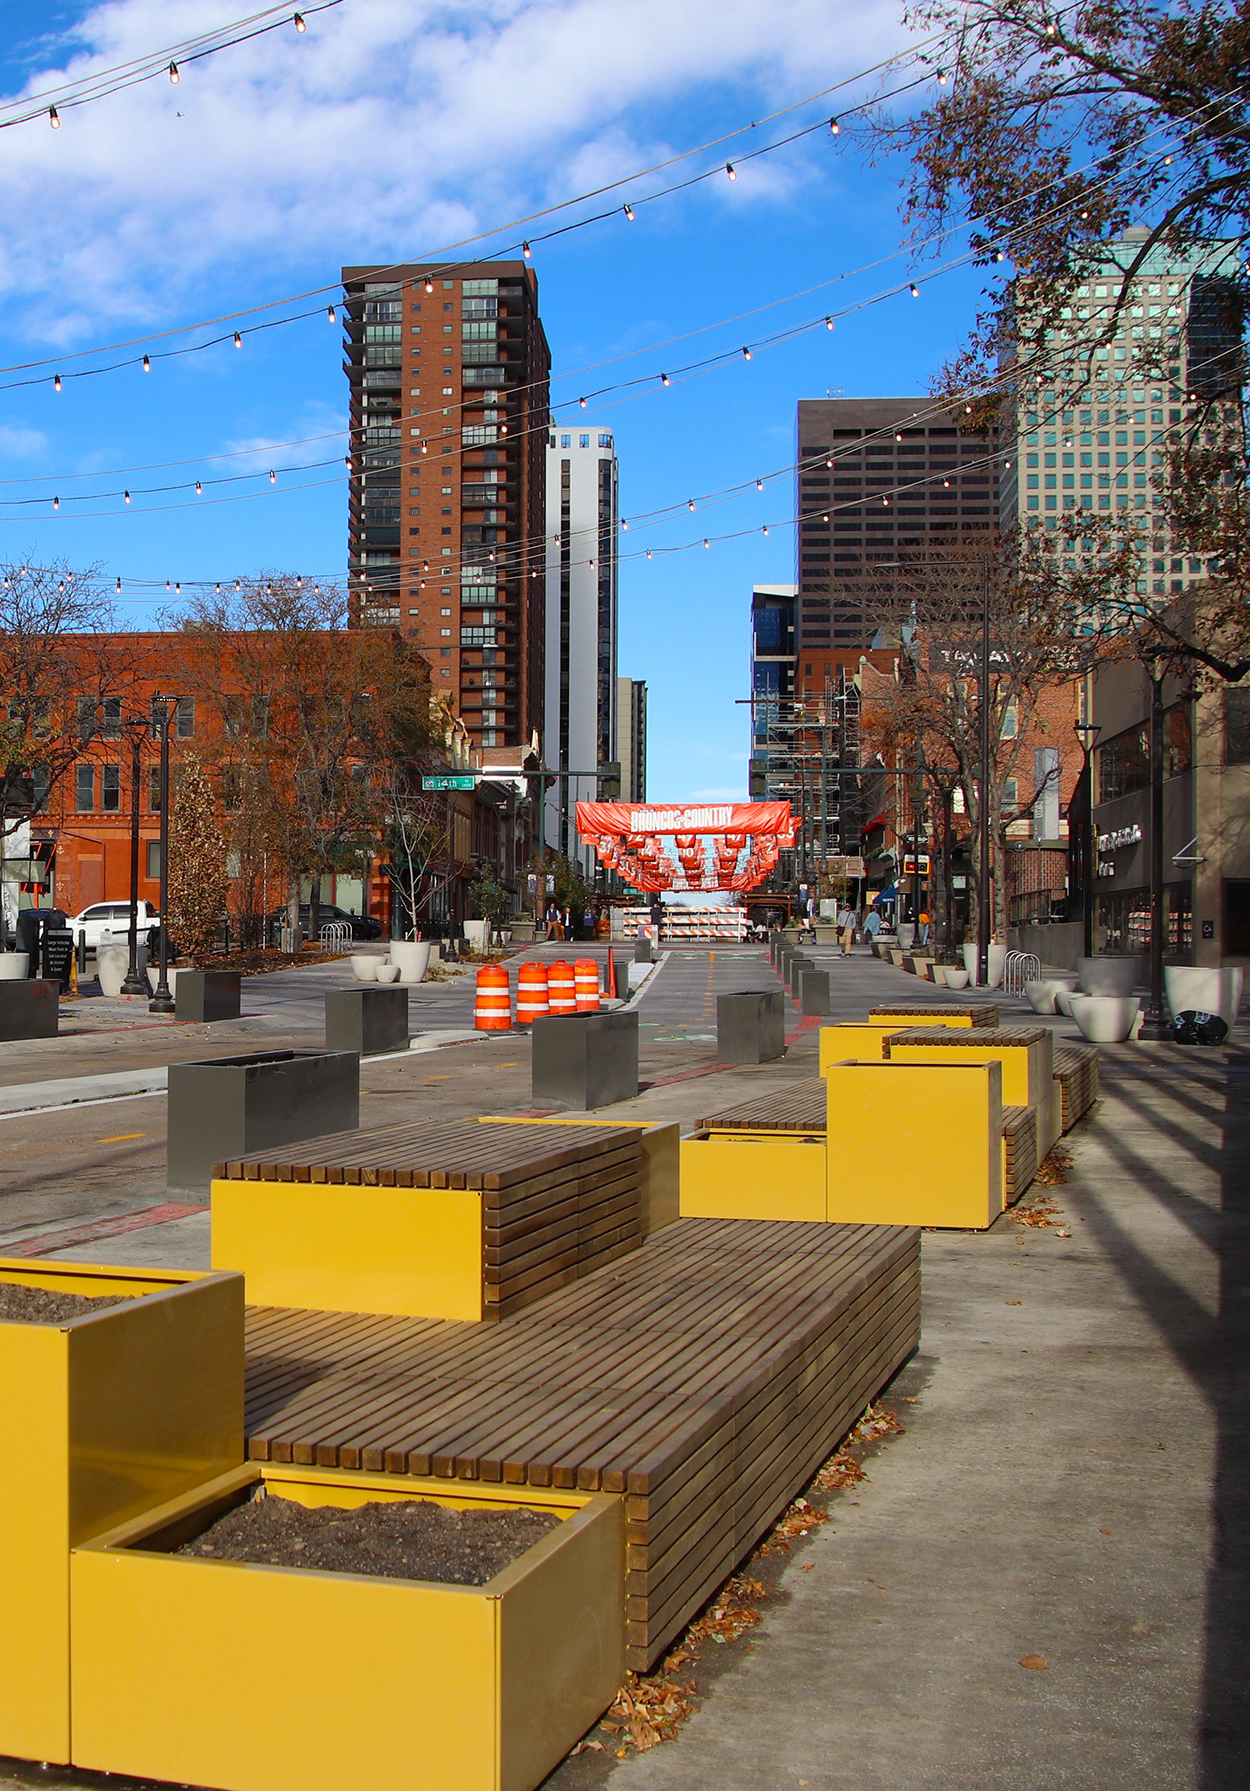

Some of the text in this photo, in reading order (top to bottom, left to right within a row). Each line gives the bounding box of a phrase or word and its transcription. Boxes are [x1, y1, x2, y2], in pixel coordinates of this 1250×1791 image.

[438, 779, 457, 787] 14th
[631, 806, 732, 832] BRONCOS COUNTRY
[683, 847, 694, 858] 10
